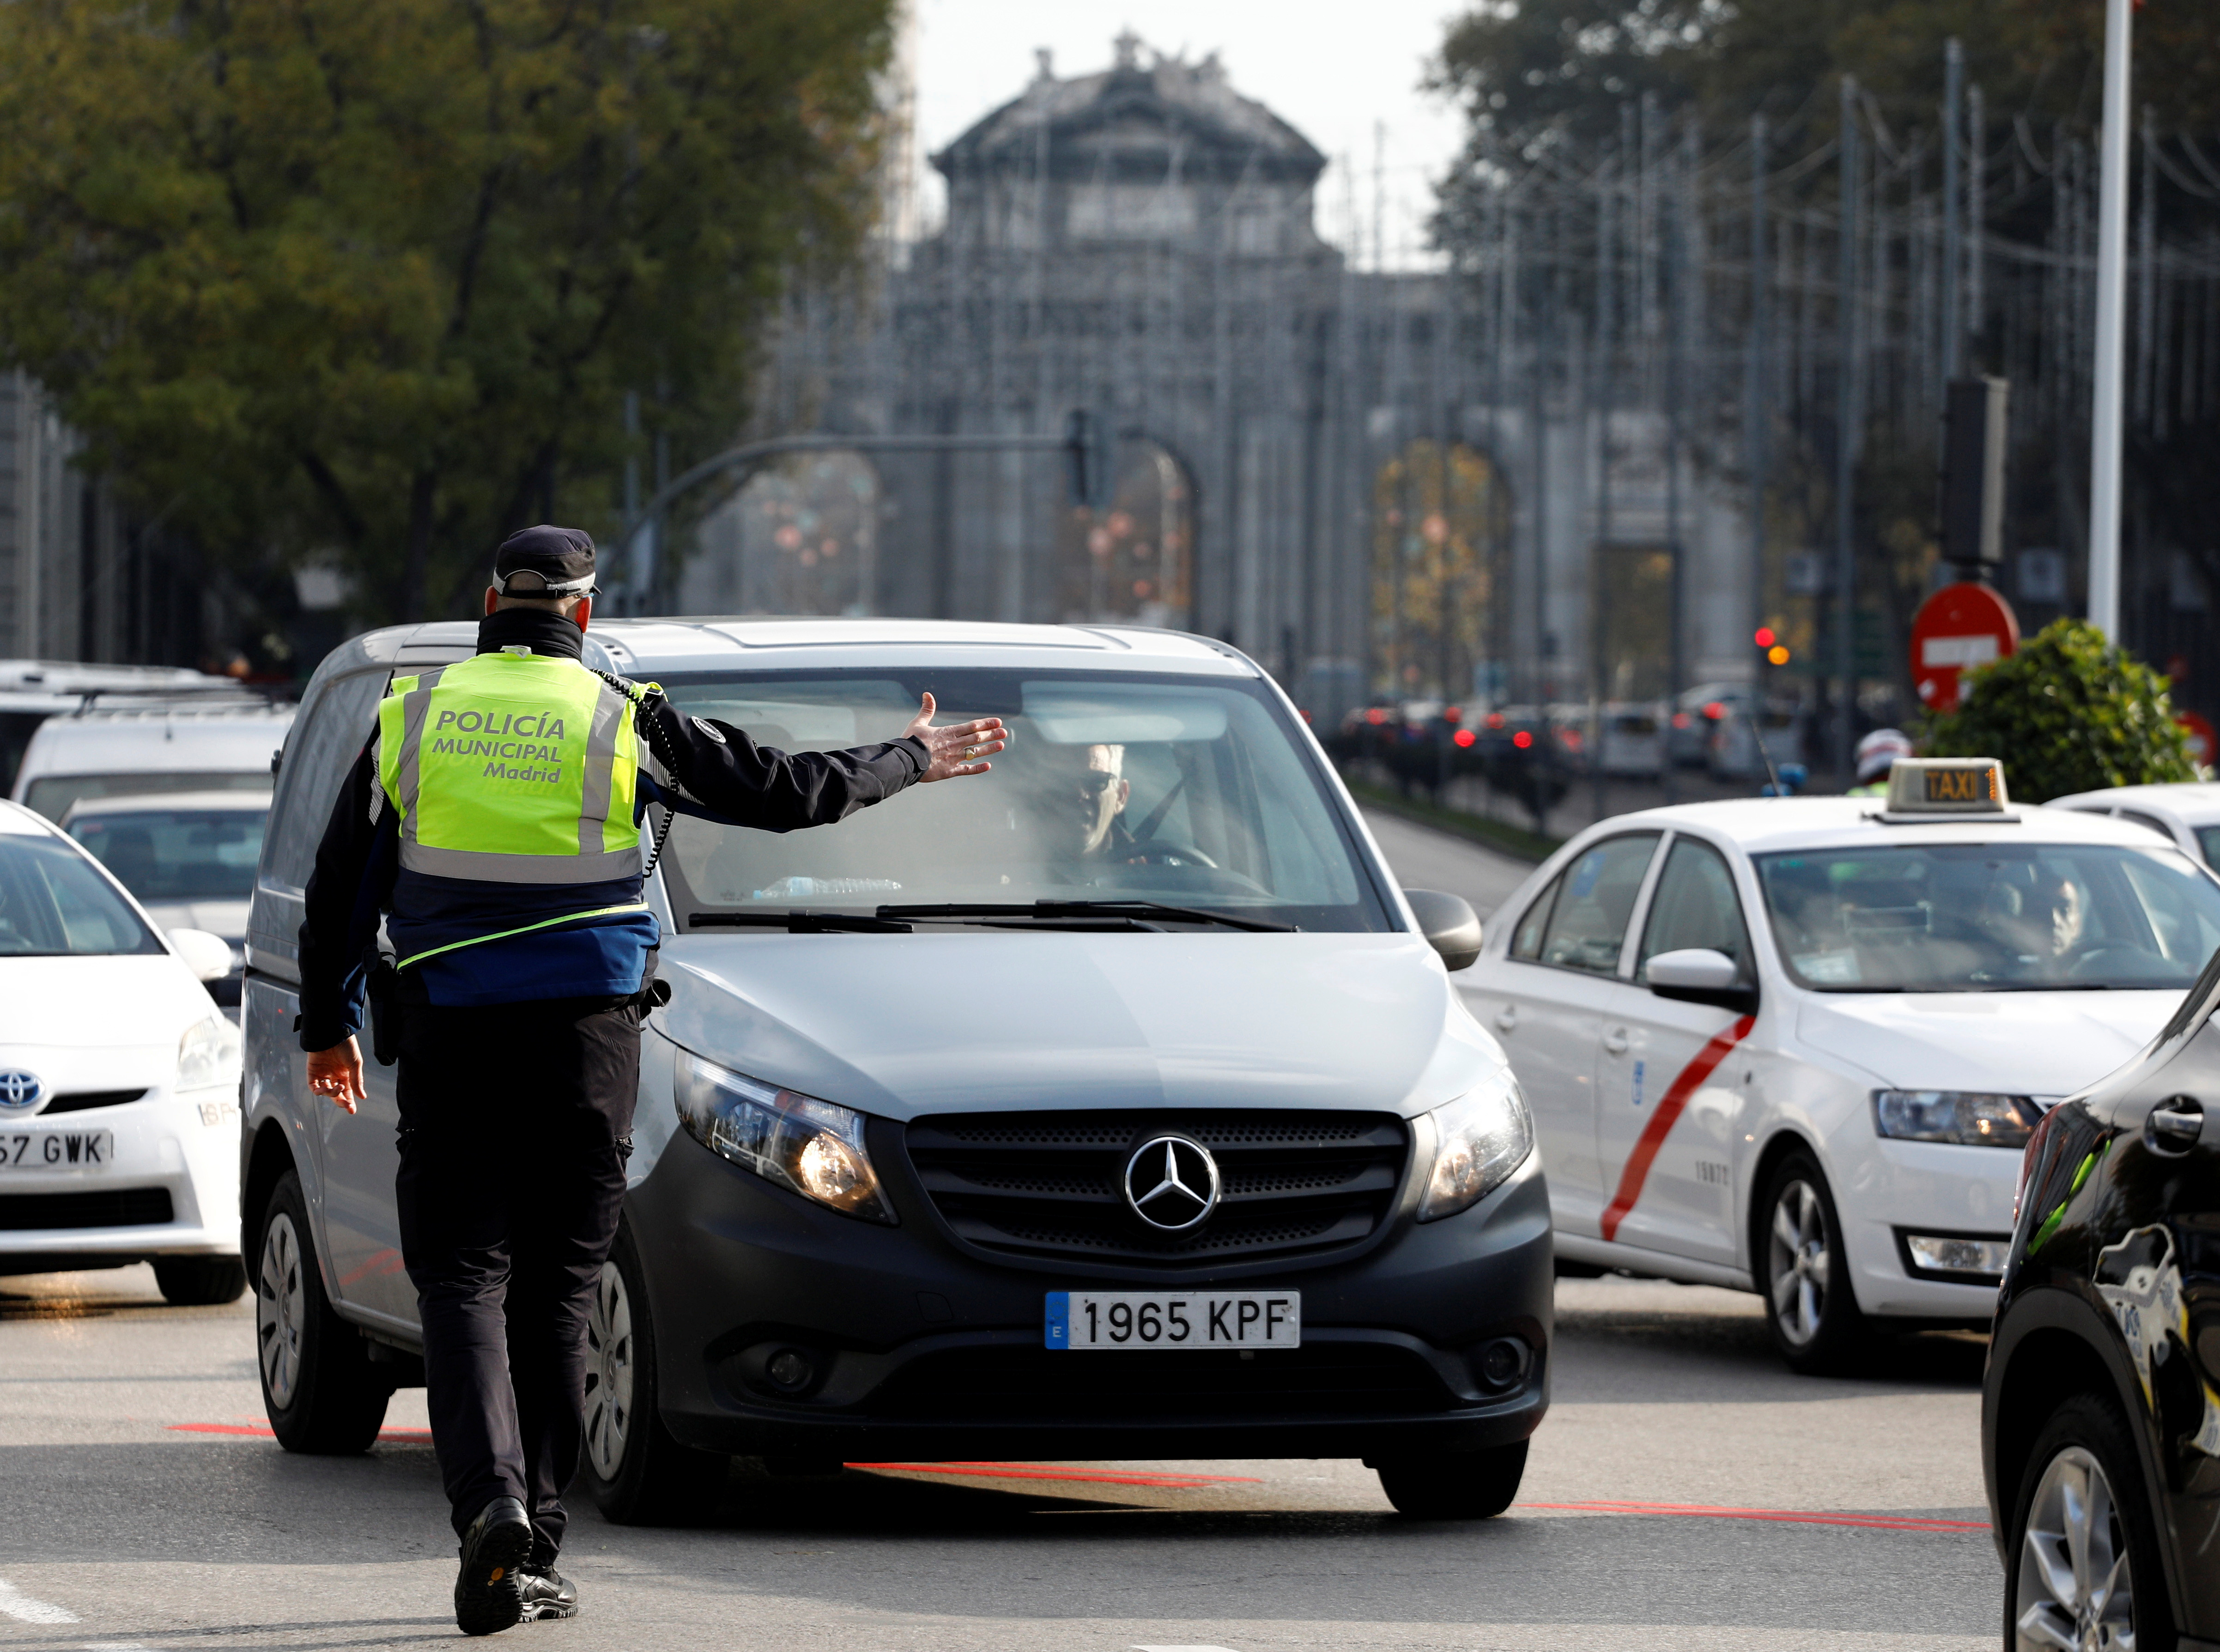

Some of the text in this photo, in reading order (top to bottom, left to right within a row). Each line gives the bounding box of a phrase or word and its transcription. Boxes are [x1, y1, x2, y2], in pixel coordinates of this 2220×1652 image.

[436, 710, 564, 740] POLICÍA
[431, 738, 562, 763] MUNICIPAL
[482, 762, 561, 783] Madrid
[1926, 771, 1977, 800] TAXI
[44, 1133, 101, 1164] GWK
[1053, 1299, 1288, 1342] E 1965 KPF
